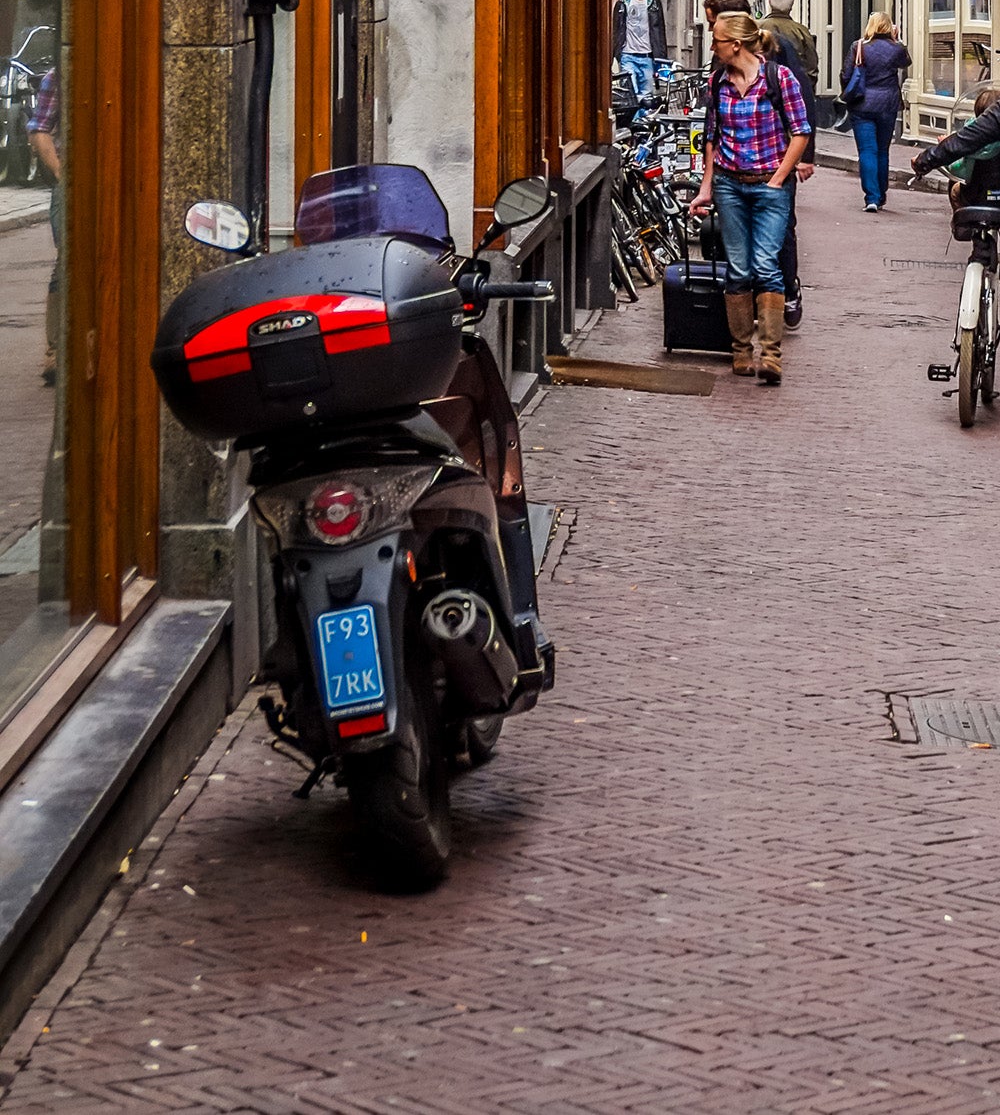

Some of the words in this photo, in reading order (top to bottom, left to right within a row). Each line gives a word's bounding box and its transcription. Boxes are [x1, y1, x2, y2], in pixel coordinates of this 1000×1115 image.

[258, 315, 307, 334] SHAD
[324, 614, 370, 644] F93
[330, 670, 377, 698] 7RK
